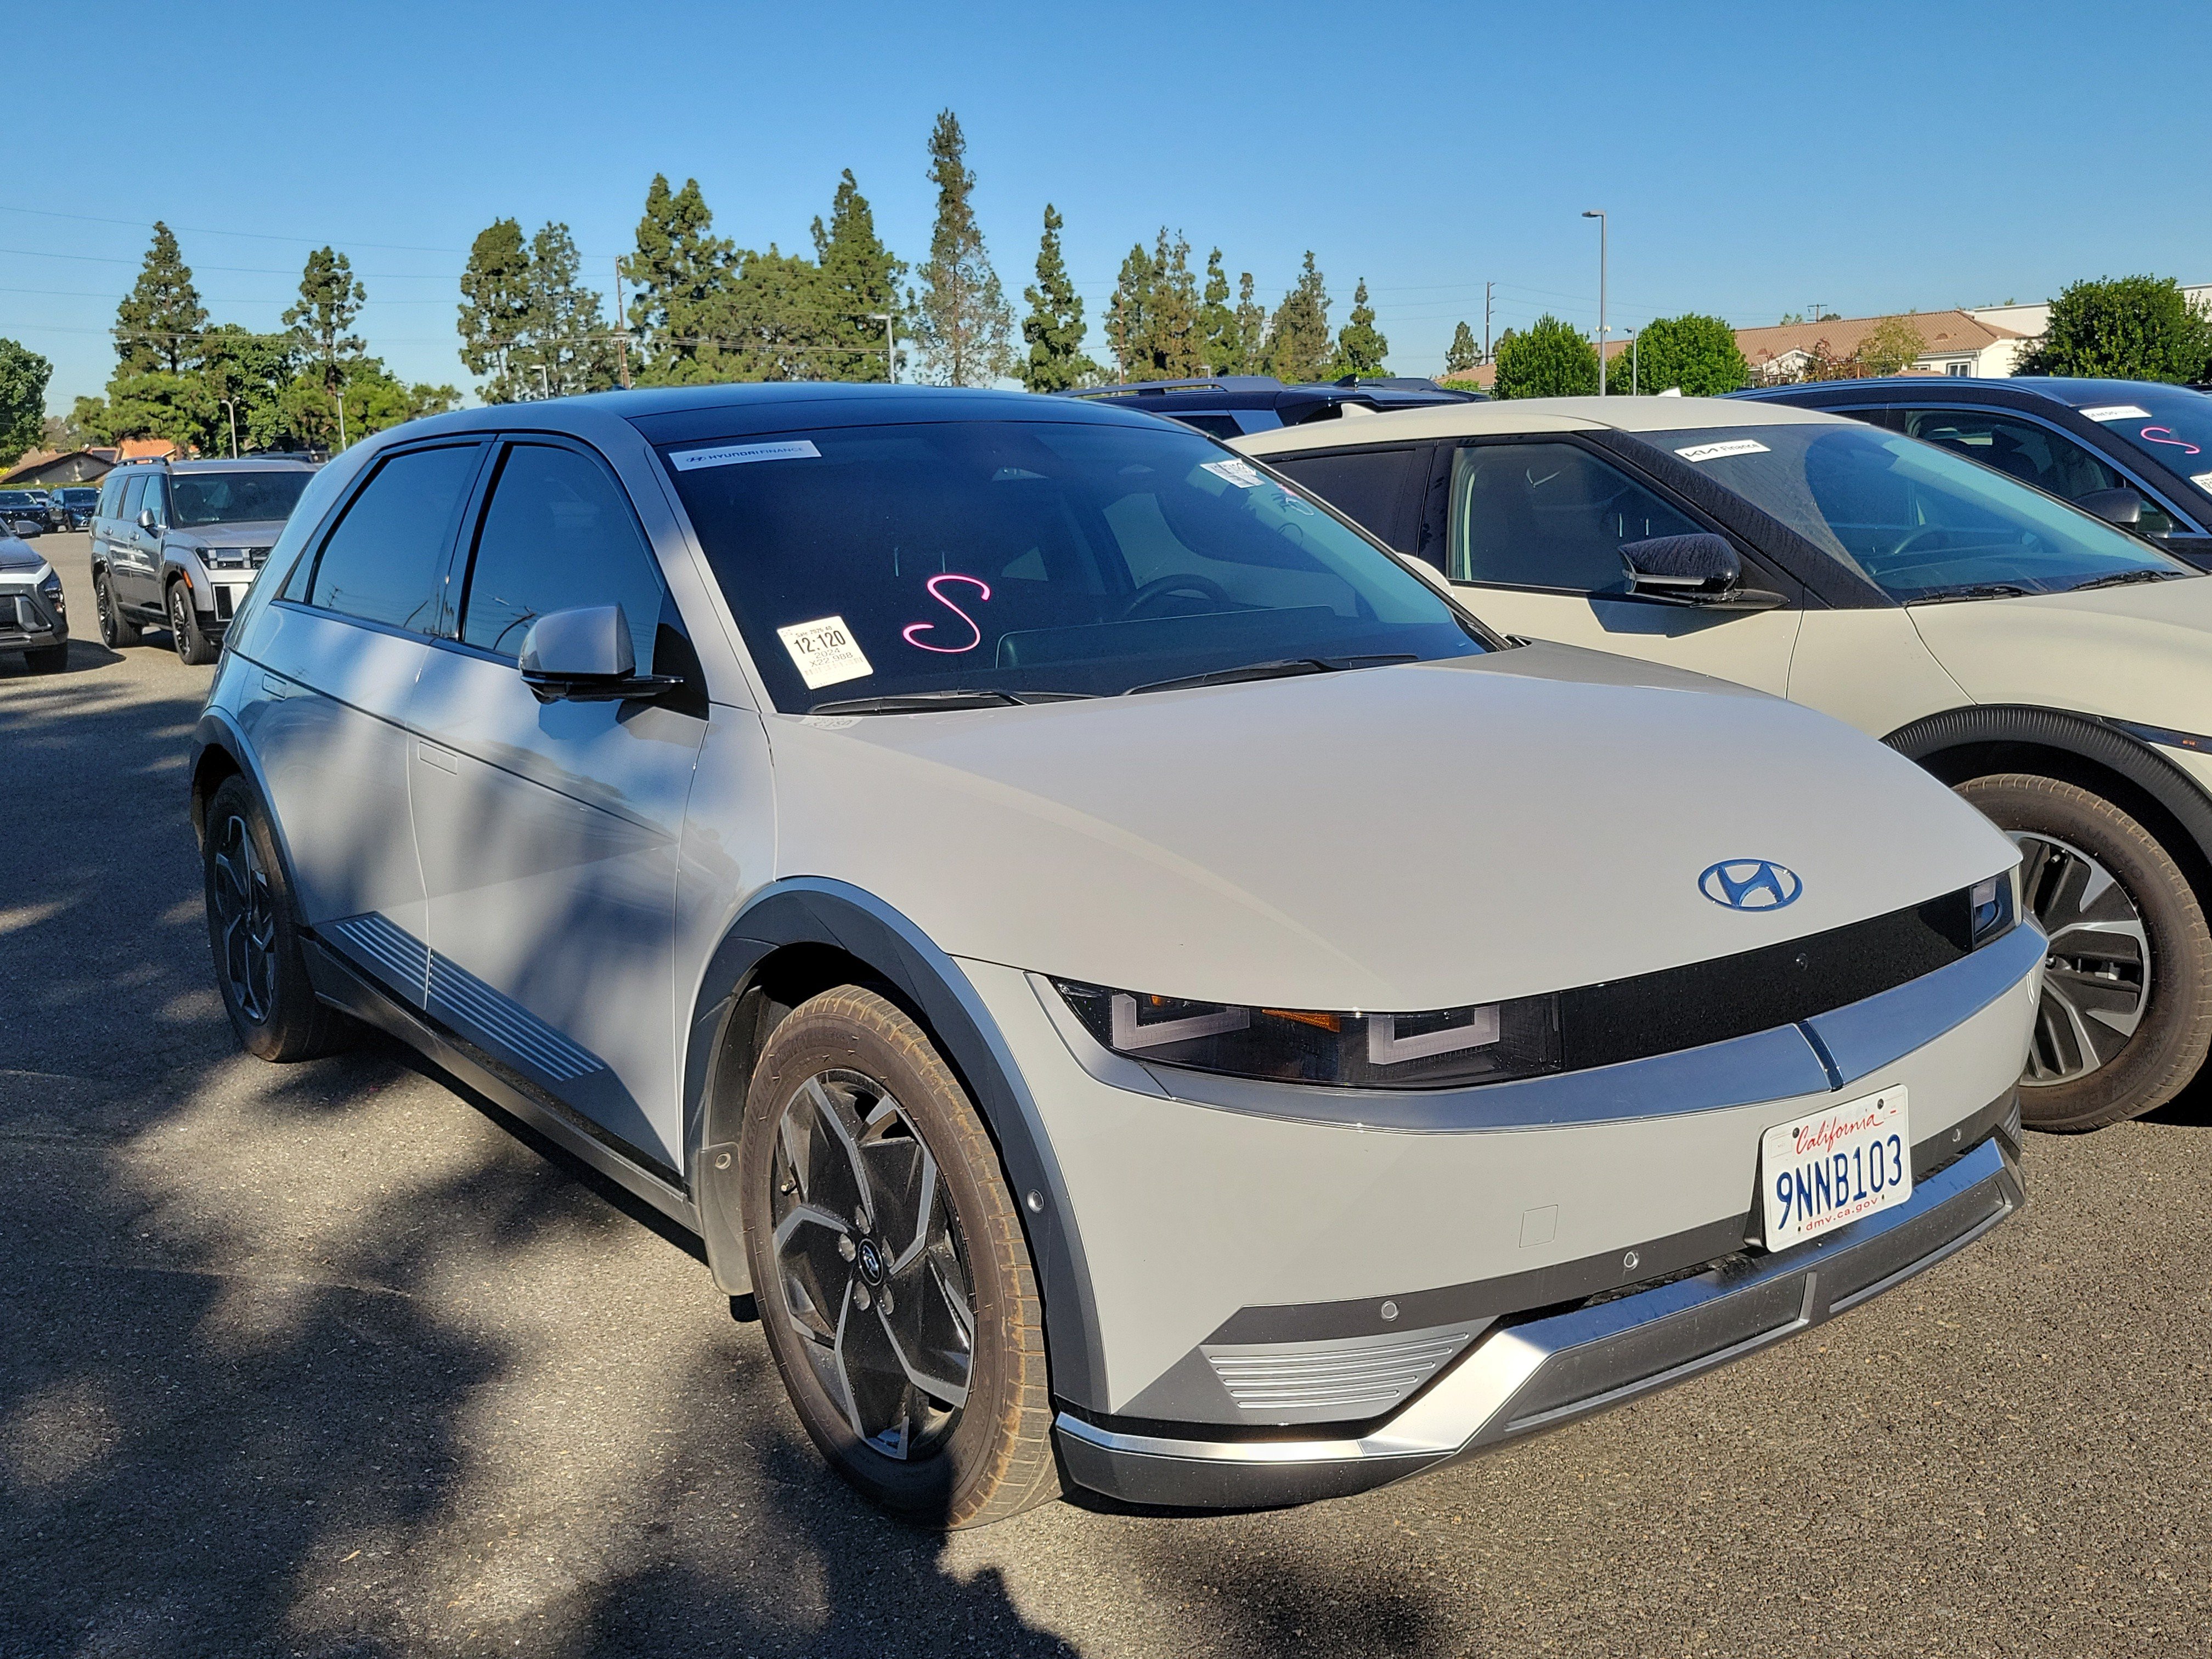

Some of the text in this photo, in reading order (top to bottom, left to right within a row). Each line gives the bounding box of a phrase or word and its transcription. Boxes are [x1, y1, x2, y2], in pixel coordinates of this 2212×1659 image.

[1719, 443, 1760, 452] Finance
[2140, 426, 2200, 454] S
[709, 450, 759, 460] HYUNDAI
[902, 574, 991, 653] S
[794, 630, 846, 654] 12:120
[814, 648, 840, 659] 2024
[1796, 1109, 1884, 1154] California
[1776, 1134, 1902, 1231] 9NNB103
[1805, 1197, 1878, 1231] dmv.ca.gov
